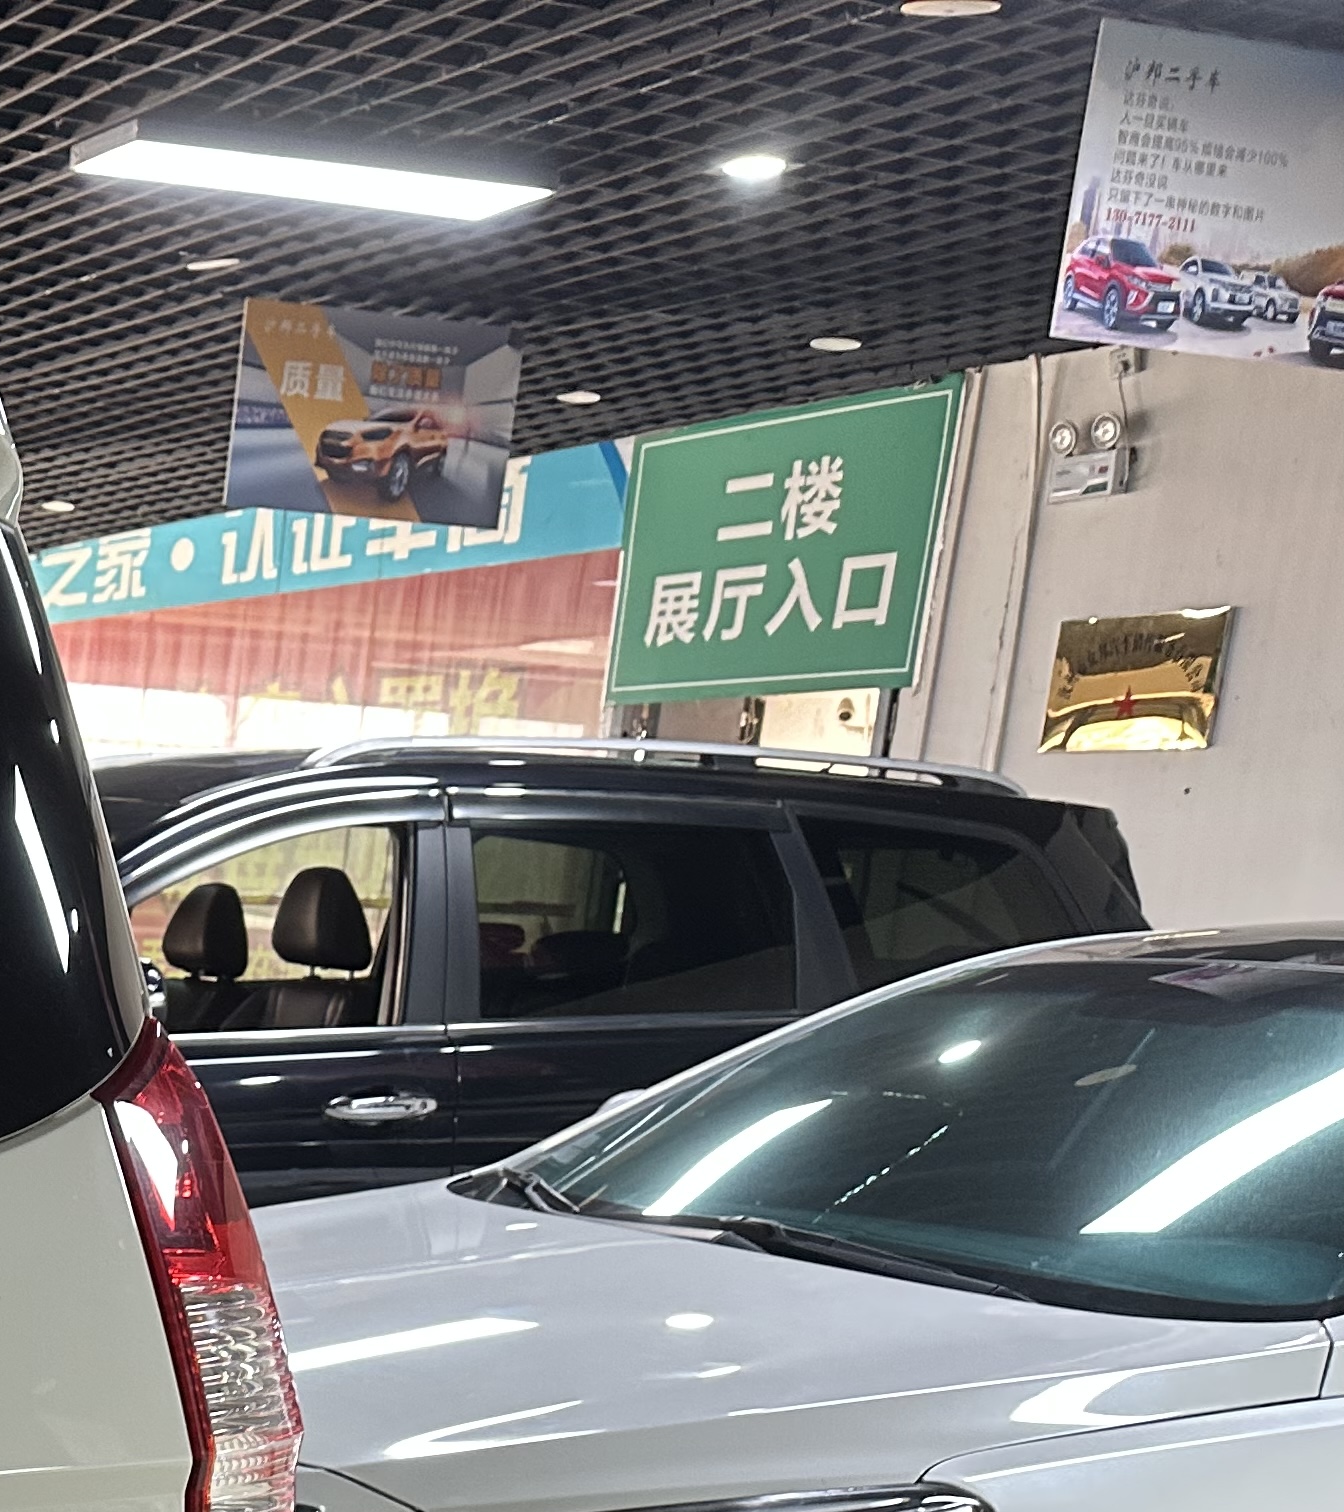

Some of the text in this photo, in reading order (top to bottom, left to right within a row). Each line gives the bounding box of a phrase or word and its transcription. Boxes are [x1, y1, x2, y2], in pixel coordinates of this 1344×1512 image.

[279, 360, 345, 402] 质量
[716, 455, 844, 542] 二楼
[643, 550, 899, 649] 展厅入口
